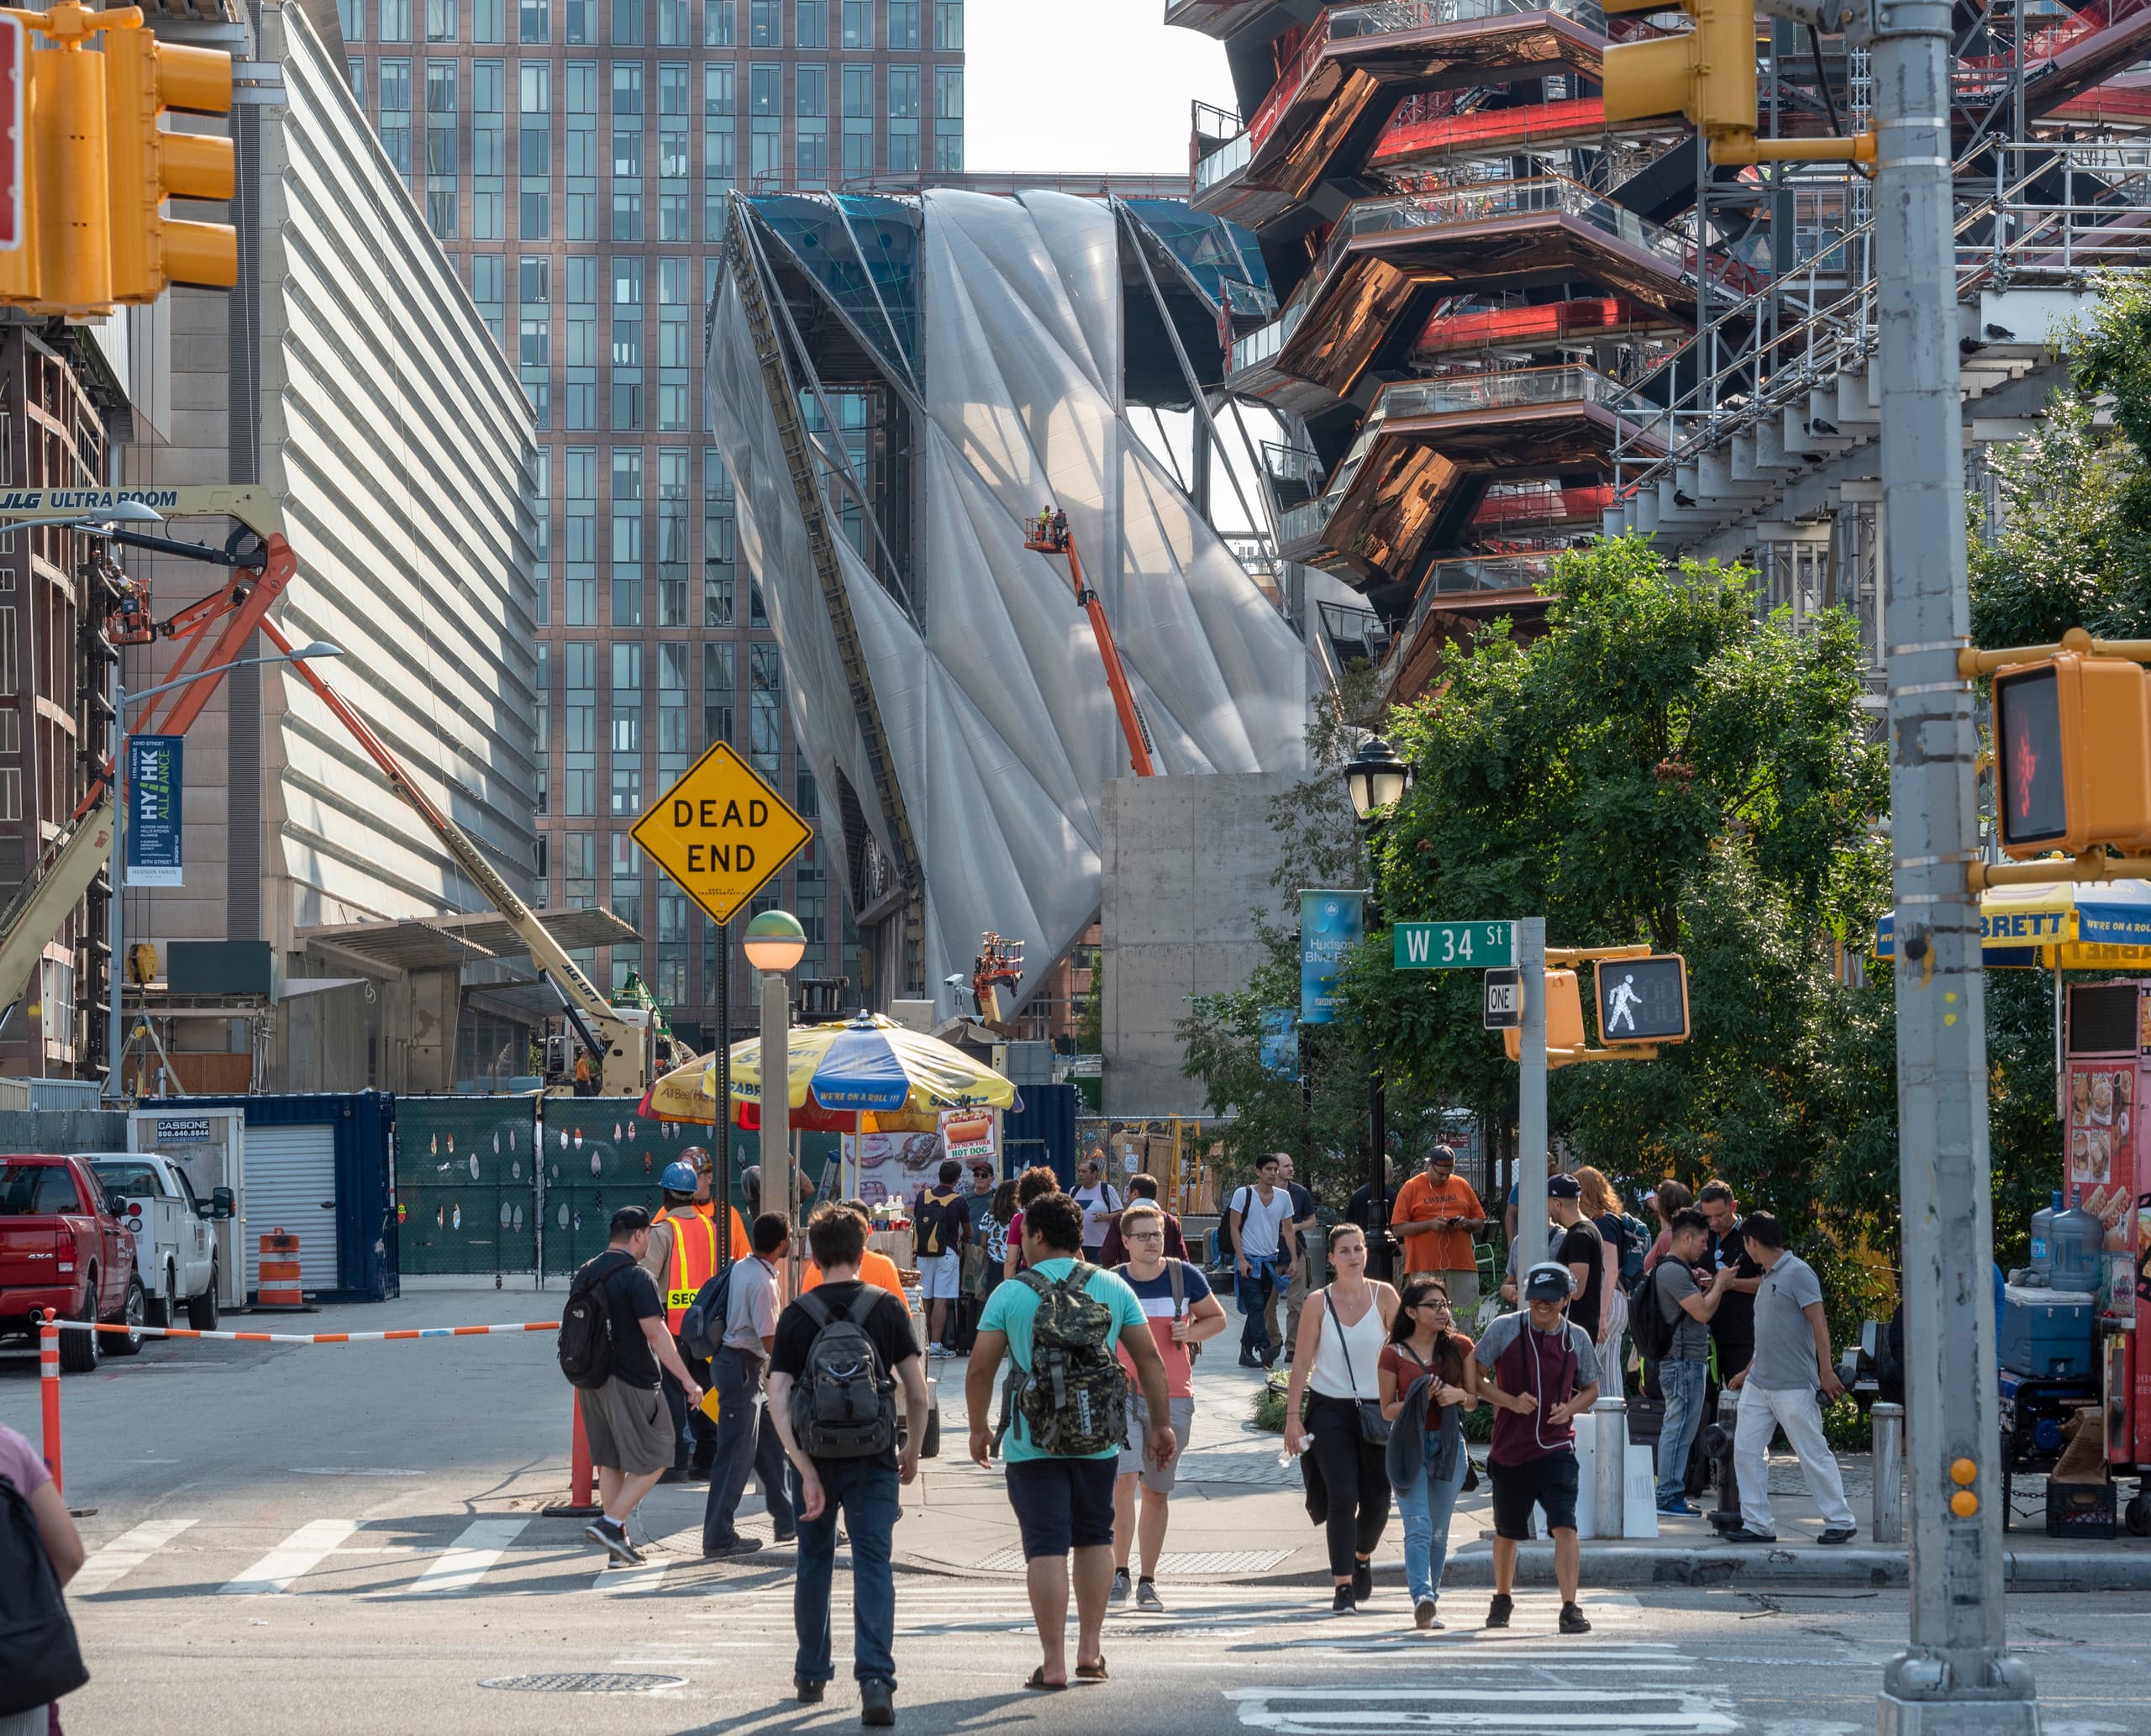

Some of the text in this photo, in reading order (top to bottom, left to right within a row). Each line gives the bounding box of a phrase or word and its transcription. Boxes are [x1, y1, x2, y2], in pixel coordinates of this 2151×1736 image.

[0, 493, 42, 509] JLG
[50, 492, 114, 508] ULTRA
[674, 799, 769, 828] DEAD
[688, 844, 755, 872] END
[2087, 919, 2111, 930] WE'RE
[2112, 921, 2125, 931] ON
[2127, 923, 2133, 932] A
[1311, 939, 1354, 950] Hudson
[1407, 925, 1503, 962] W 34 St
[561, 964, 600, 1002] JLG LIFT
[1491, 987, 1510, 1009] ONE
[820, 1092, 845, 1101] WE'RE
[158, 1121, 209, 1129] CASSONE
[951, 1146, 987, 1157] HOT DOG
